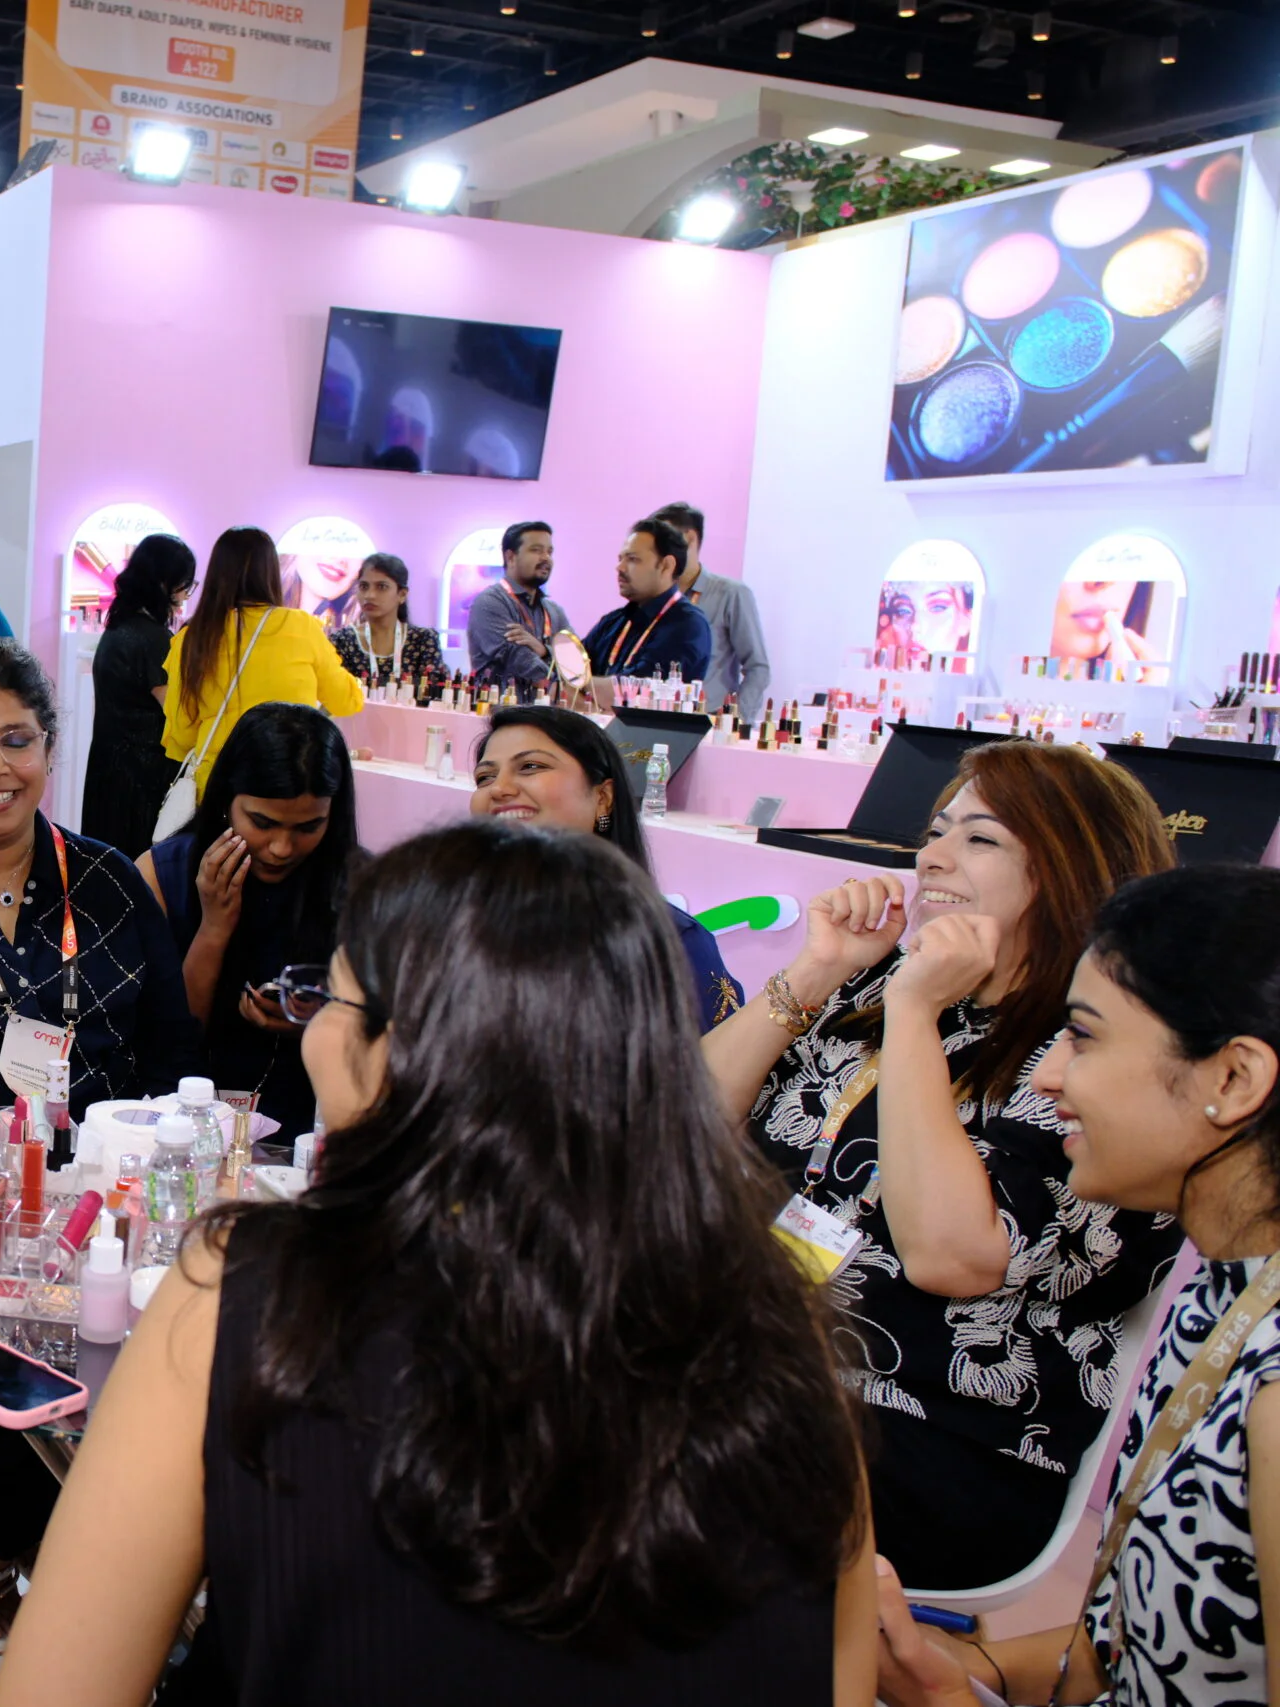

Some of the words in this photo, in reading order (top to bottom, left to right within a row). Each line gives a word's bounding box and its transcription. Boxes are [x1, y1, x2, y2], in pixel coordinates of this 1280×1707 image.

[138, 10, 167, 24] ADULT
[208, 22, 237, 37] WIPES
[239, 27, 247, 38] &
[249, 28, 292, 47] FEMININE
[174, 41, 209, 57] BOOTH
[183, 60, 219, 79] A-122
[120, 91, 169, 110] BRAND
[175, 101, 273, 127] ASSOCIATIONS
[1160, 809, 1208, 840] apco
